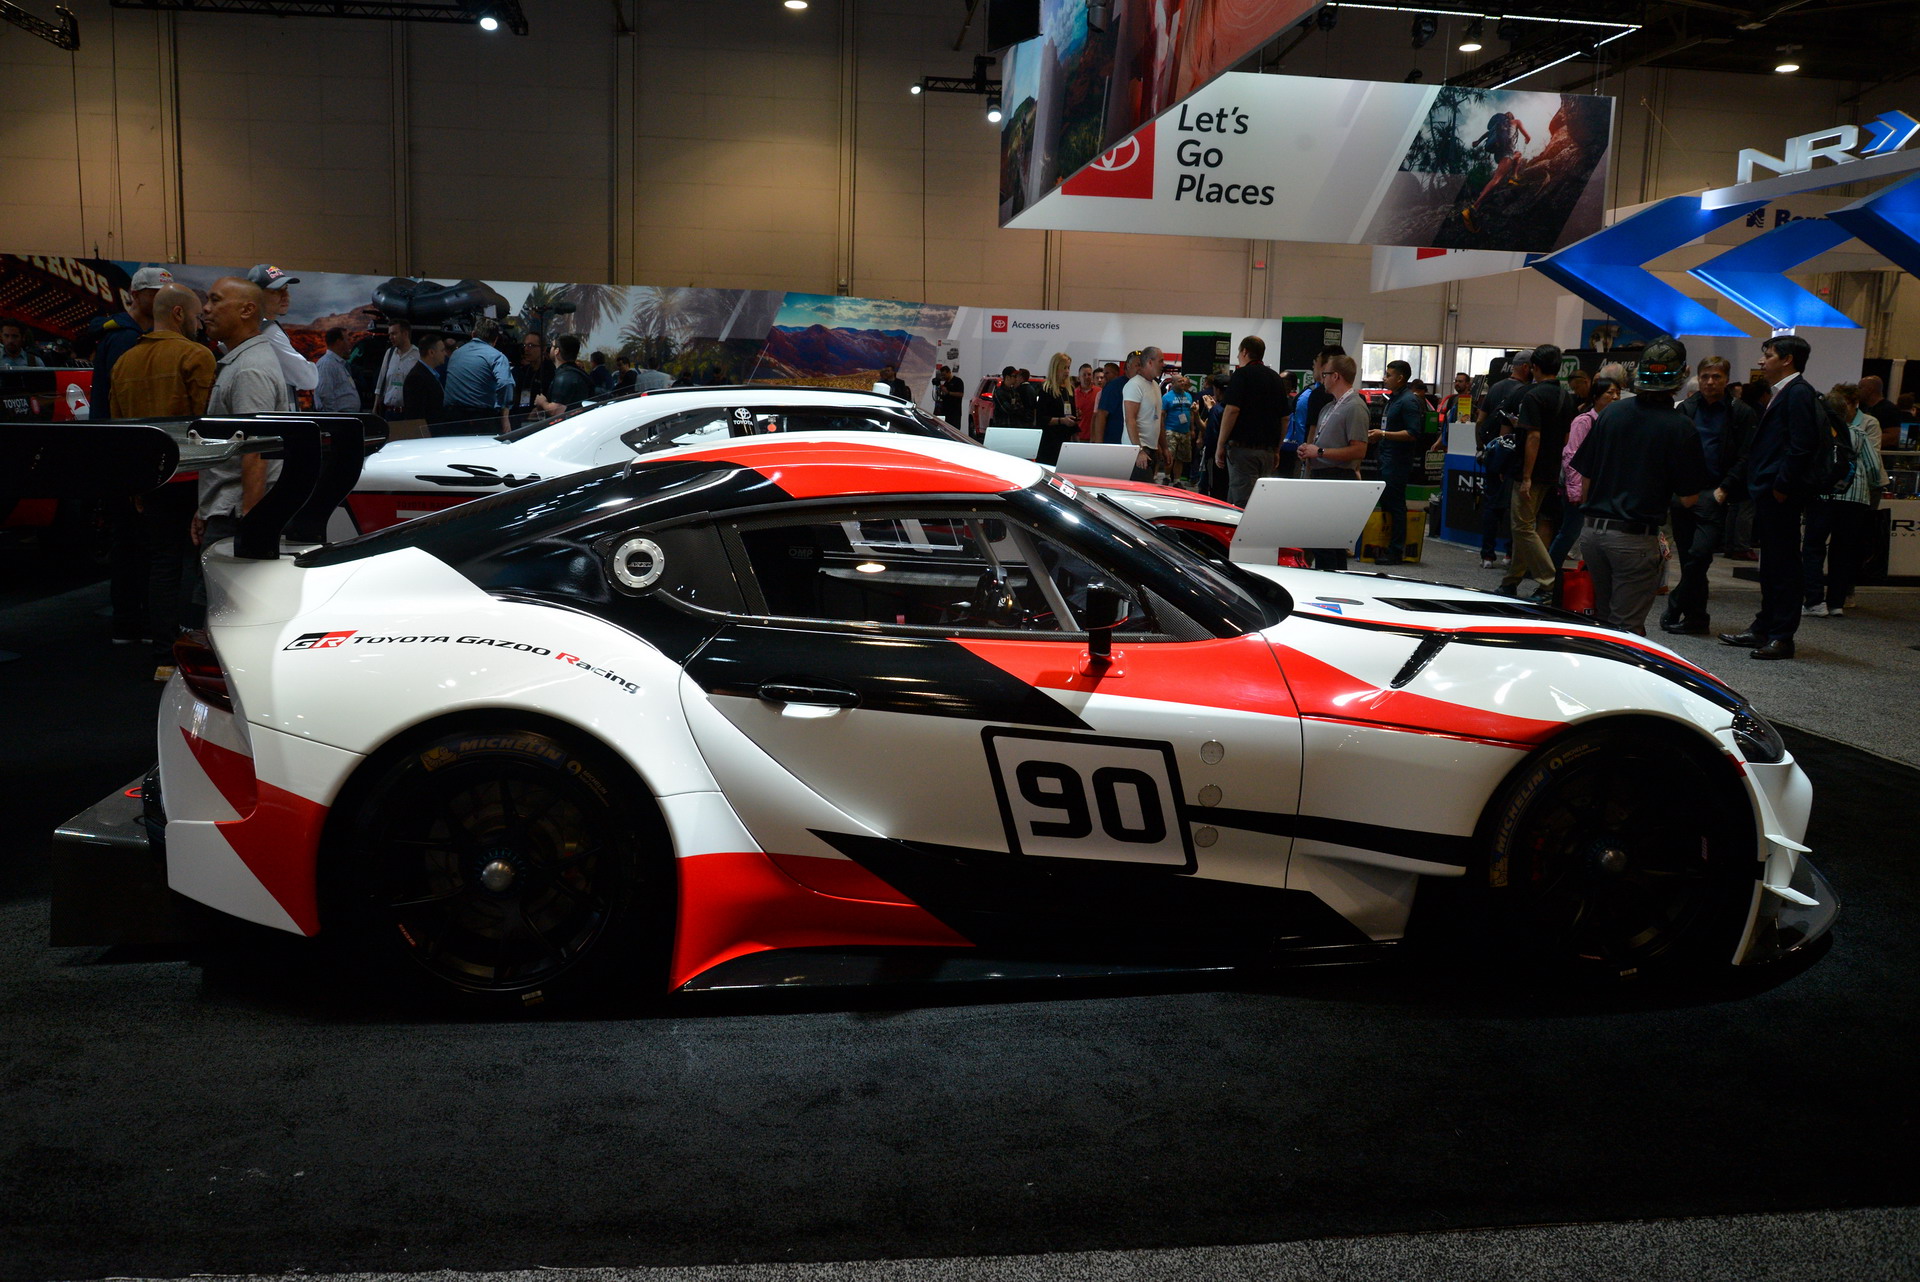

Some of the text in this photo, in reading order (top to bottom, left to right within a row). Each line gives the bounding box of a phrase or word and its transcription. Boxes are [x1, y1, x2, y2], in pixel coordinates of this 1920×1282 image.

[1176, 138, 1223, 168] Go
[1175, 173, 1275, 206] Places
[1011, 320, 1060, 330] Accessories
[3, 398, 30, 409] TOYOTA
[732, 419, 754, 427] TOYOTA
[787, 548, 814, 560] OMP
[283, 634, 642, 695] GR TOYOTA GAZOO Racing
[459, 736, 563, 761] MICHELIN
[1015, 759, 1167, 844] 90
[1494, 769, 1546, 853] MICHELIN
